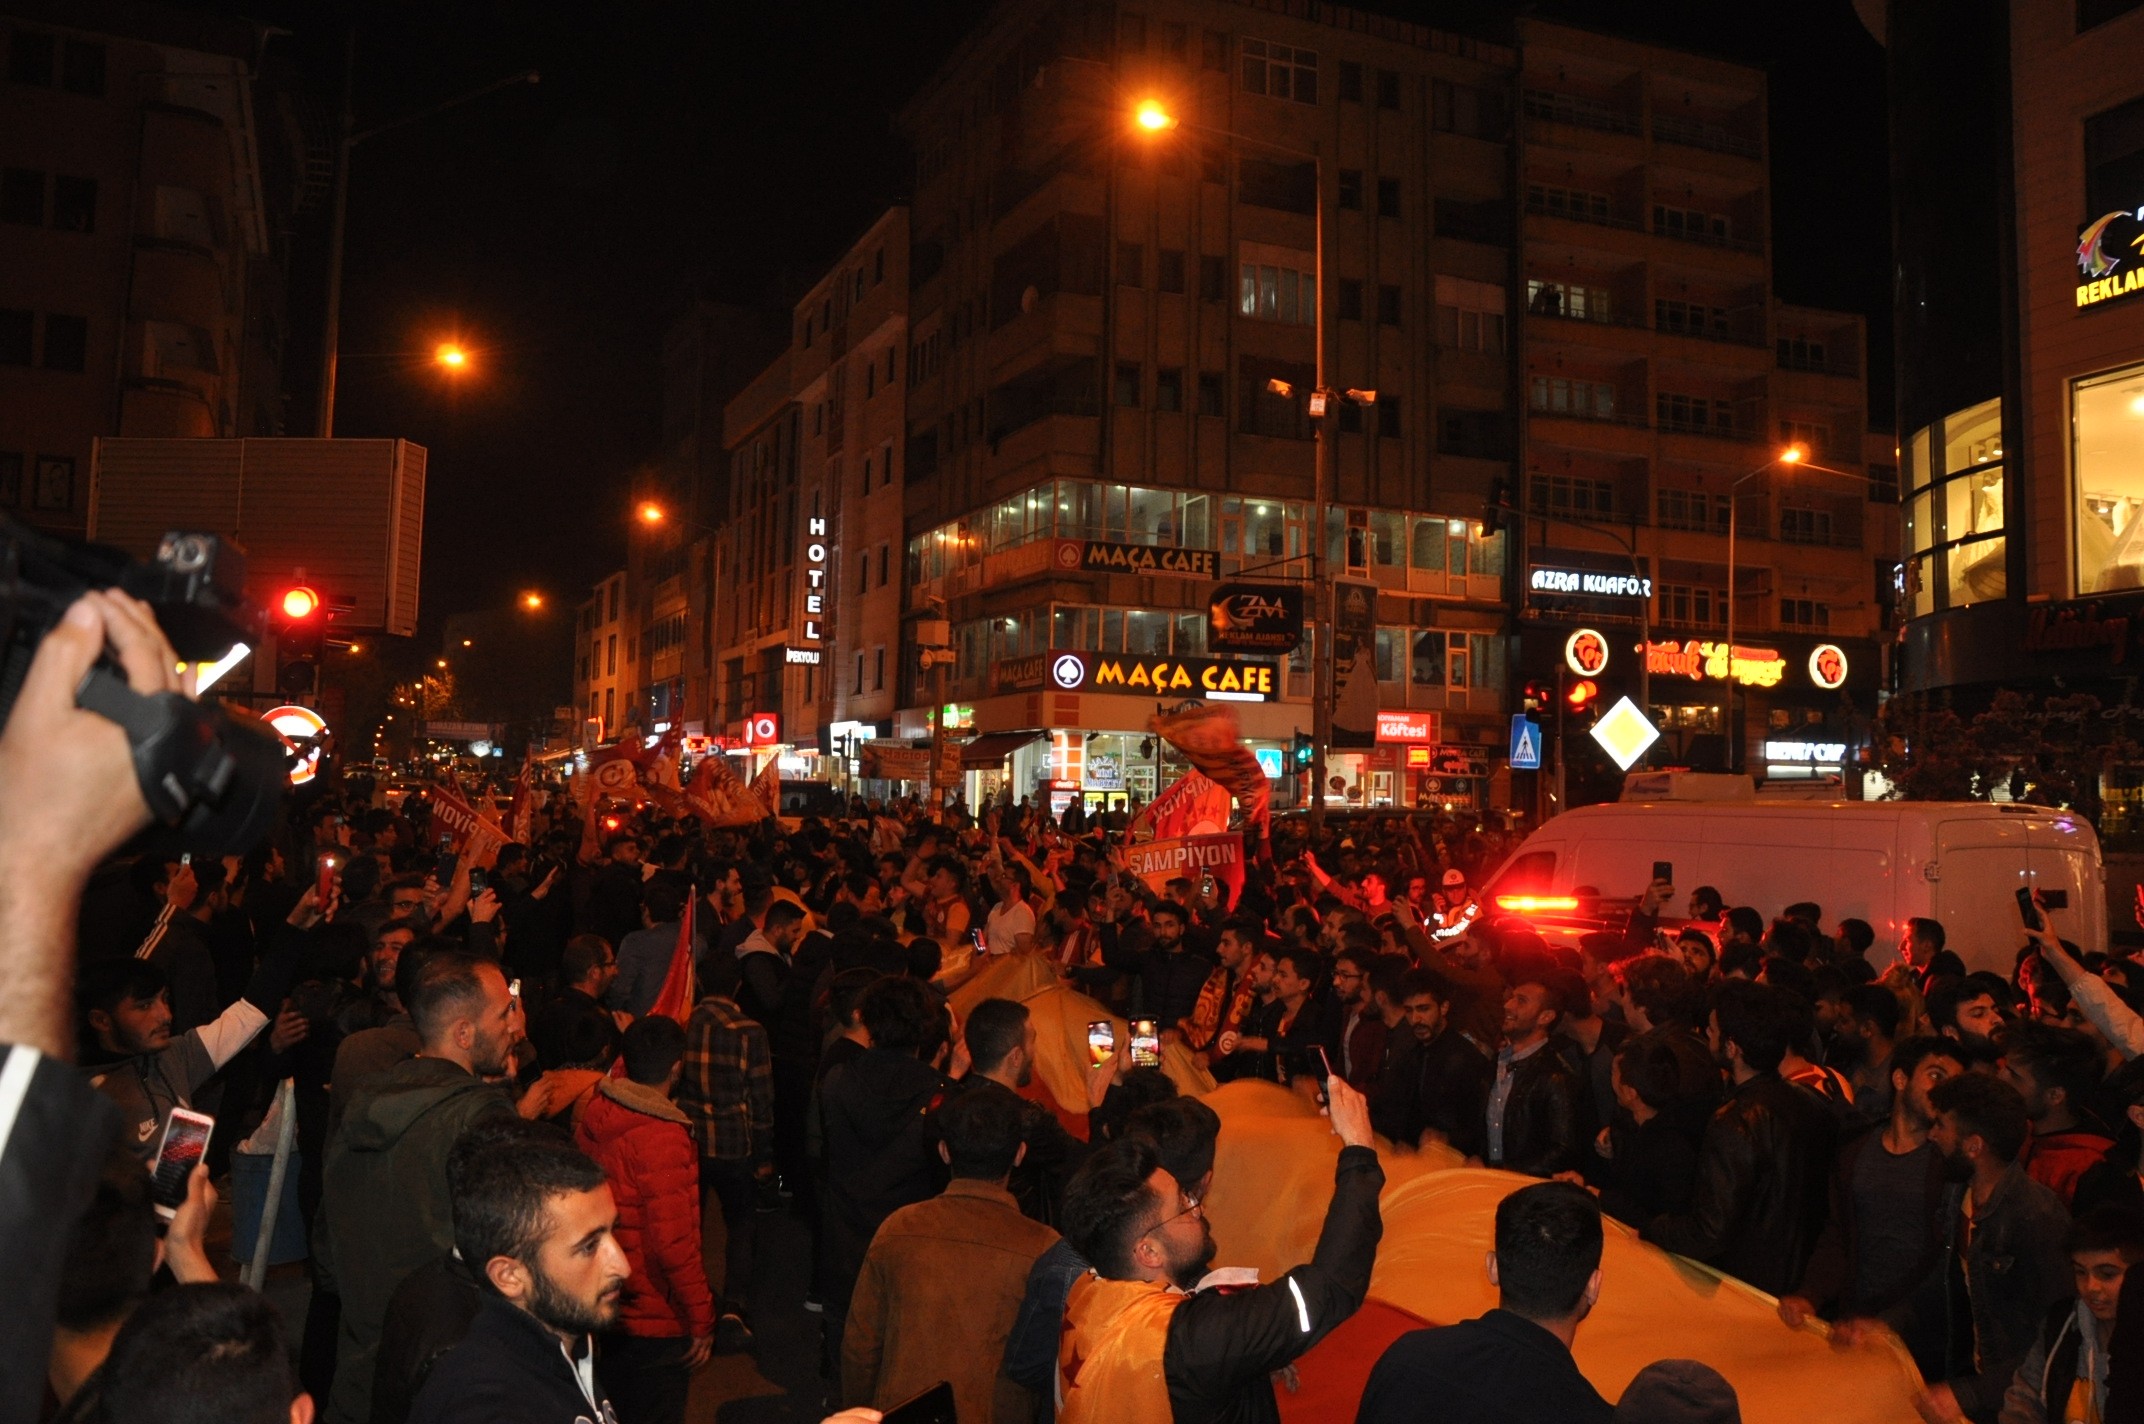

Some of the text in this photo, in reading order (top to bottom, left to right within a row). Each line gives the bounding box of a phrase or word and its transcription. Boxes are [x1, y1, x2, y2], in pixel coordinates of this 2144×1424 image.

[1088, 543, 1213, 574] MAÇA CAFE
[805, 518, 825, 639] HOTEL
[1531, 570, 1580, 592] AZRA
[1218, 631, 1254, 641] REKLAM
[786, 647, 820, 664] İPEKYOLU
[1024, 658, 1043, 680] CAFE
[1095, 660, 1271, 695] MAÇA CAFE
[1381, 722, 1427, 738] Köftesi
